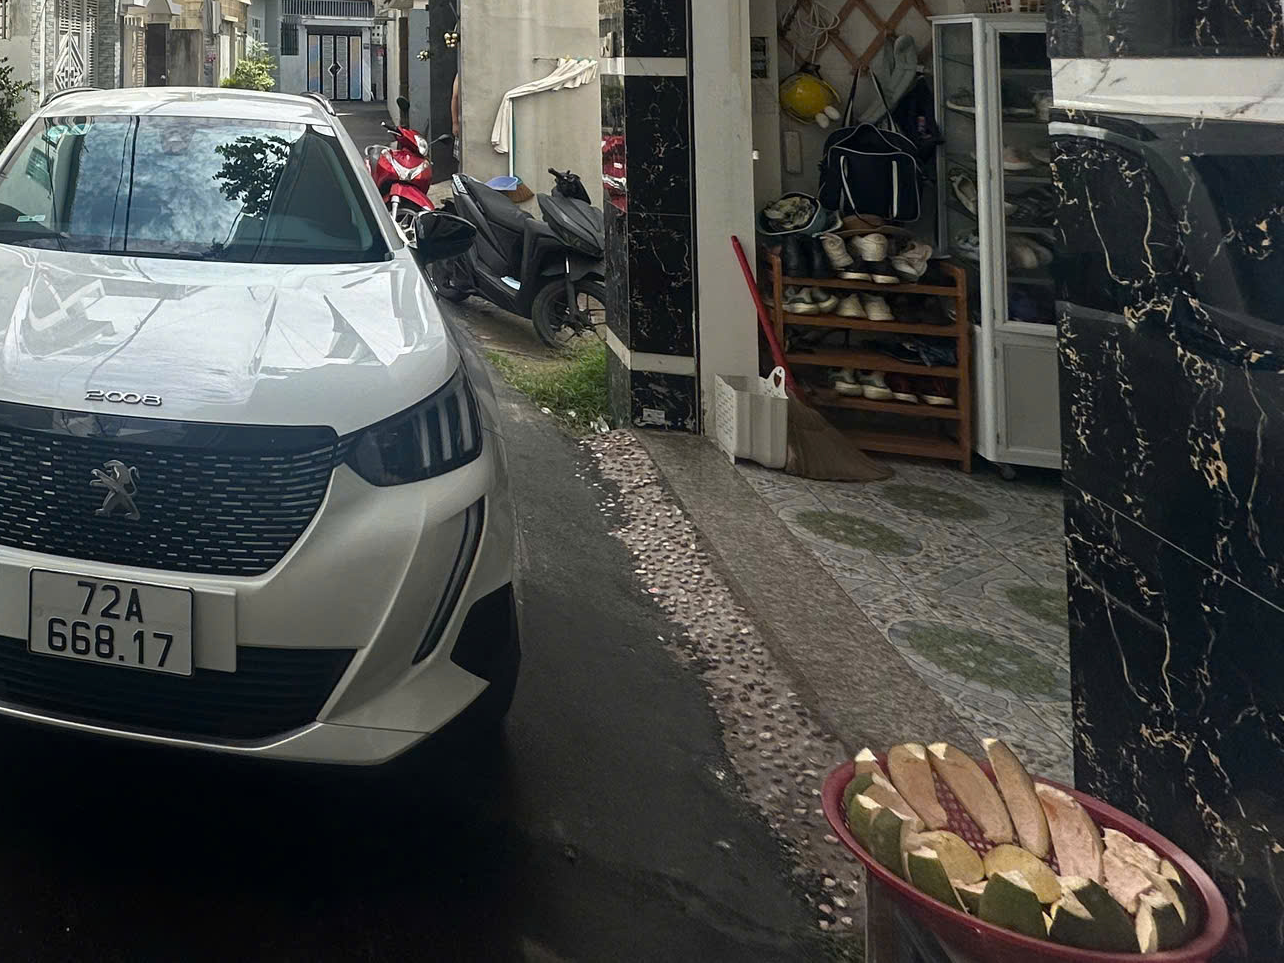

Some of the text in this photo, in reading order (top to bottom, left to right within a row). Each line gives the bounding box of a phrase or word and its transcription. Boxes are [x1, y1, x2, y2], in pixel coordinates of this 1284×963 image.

[84, 389, 163, 407] 2008
[77, 580, 144, 624] 72A
[47, 617, 174, 668] 668.17
